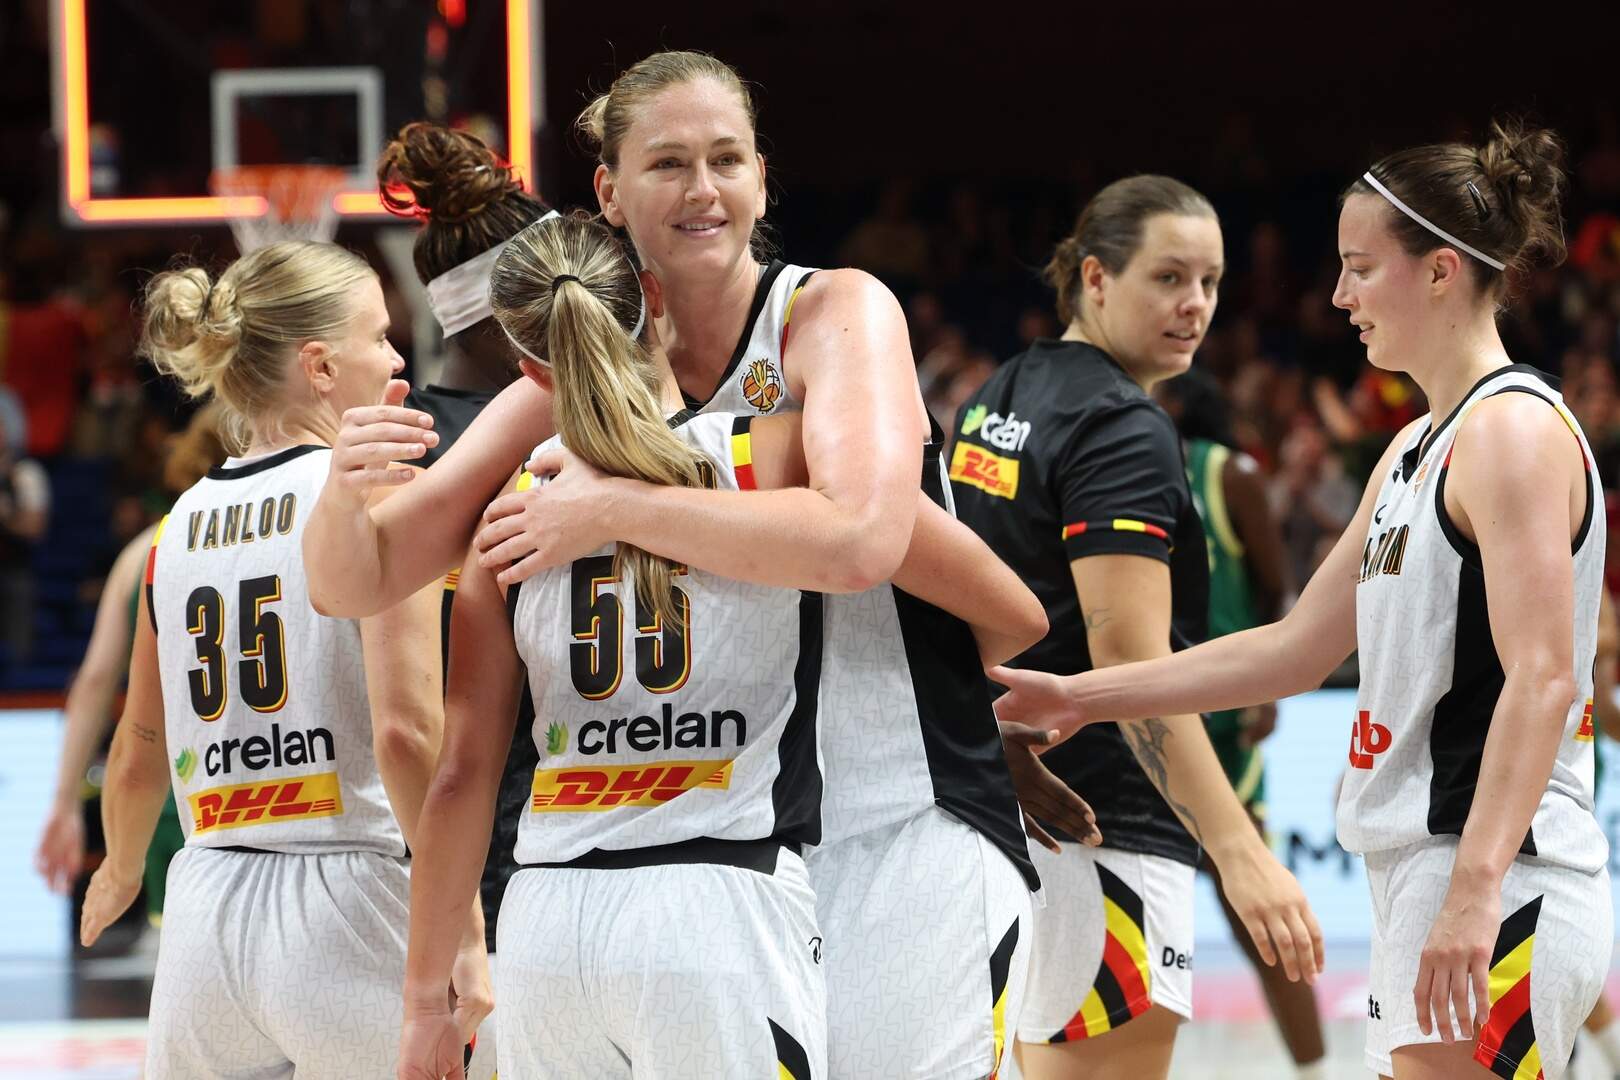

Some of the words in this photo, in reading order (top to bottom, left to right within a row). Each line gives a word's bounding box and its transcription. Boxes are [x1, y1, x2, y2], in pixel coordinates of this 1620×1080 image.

[980, 412, 1031, 452] celan
[187, 492, 296, 552] VANLOO
[186, 574, 289, 721] 35
[569, 554, 692, 701] 55
[205, 723, 335, 777] crelan
[577, 703, 747, 756] crelan
[198, 782, 313, 830] DHL
[550, 766, 696, 806] DHL
